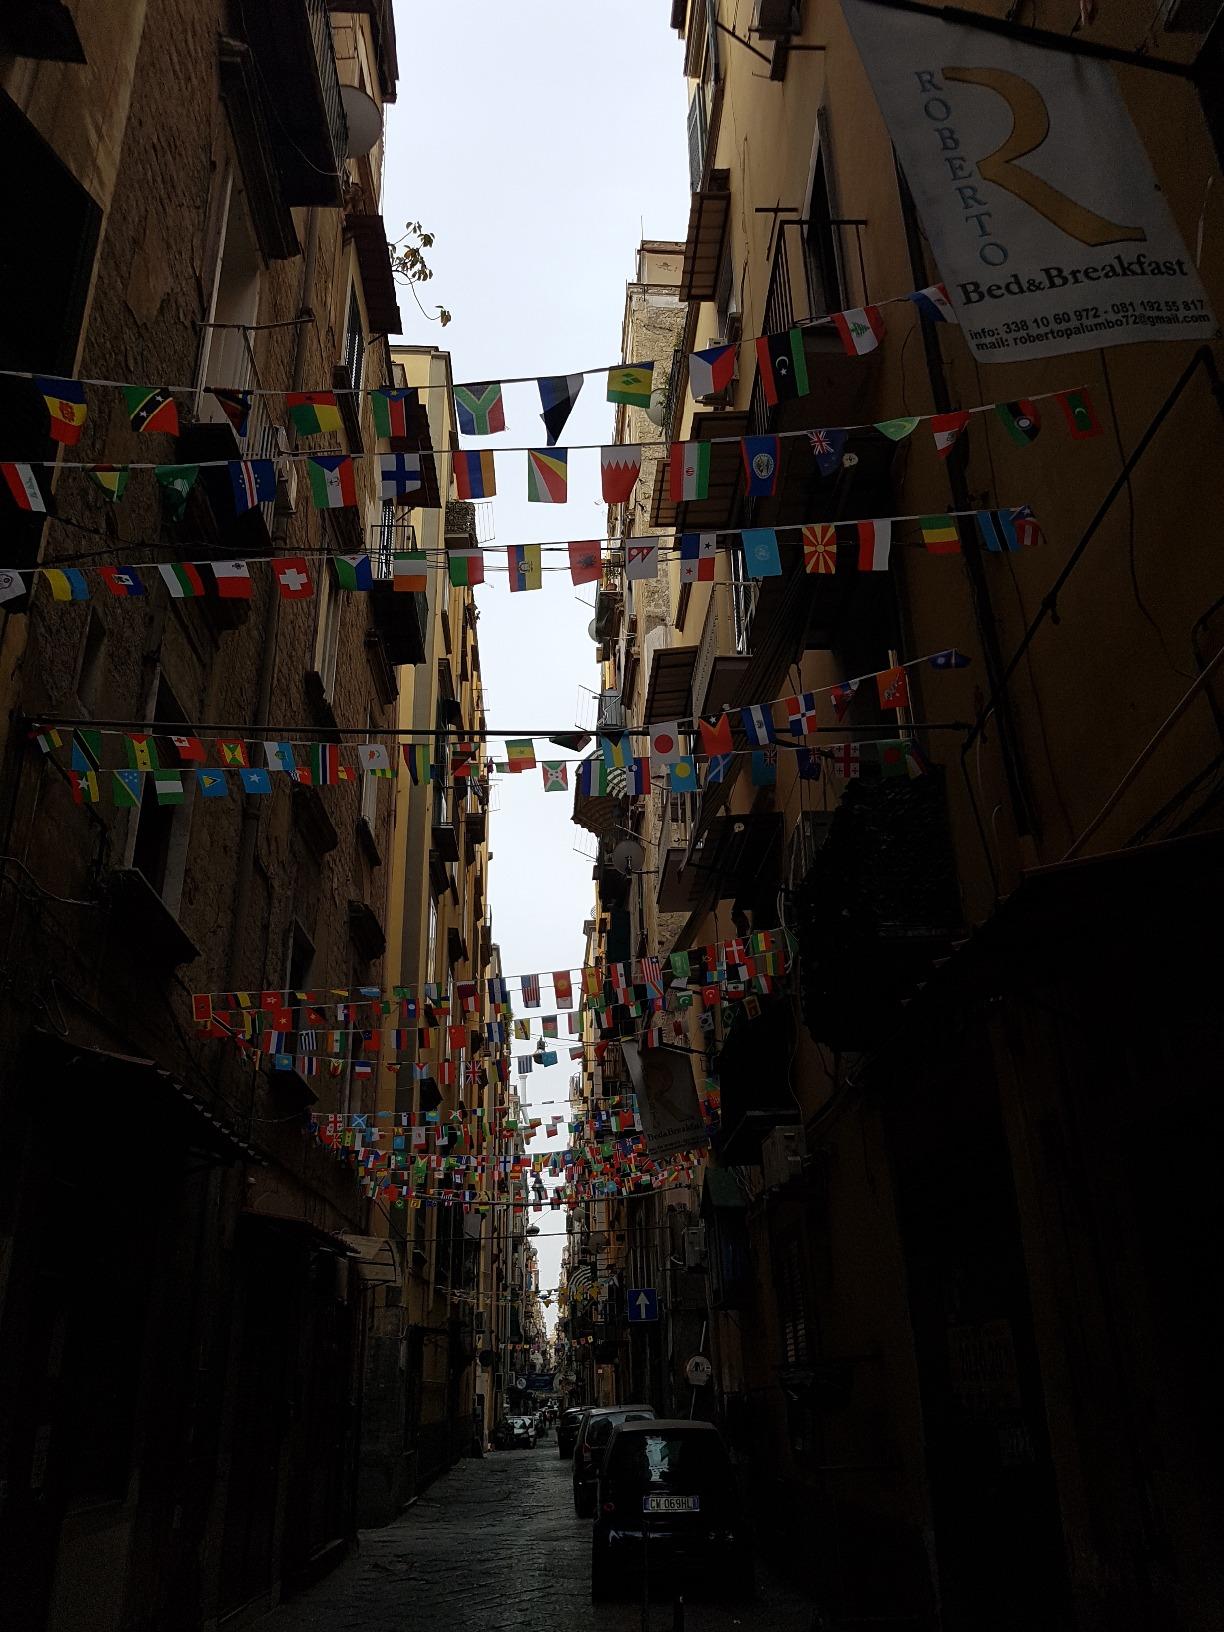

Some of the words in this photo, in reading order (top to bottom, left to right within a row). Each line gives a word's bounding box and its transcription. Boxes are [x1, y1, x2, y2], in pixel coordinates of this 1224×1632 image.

[915, 71, 1008, 266] ROBERTO
[957, 253, 1188, 305] Bed&Breakfast
[970, 327, 999, 340] info:
[1002, 321, 1029, 335] 338
[1032, 316, 1050, 330] 10
[1054, 312, 1071, 326] 60
[1074, 307, 1100, 323] 972
[1111, 301, 1136, 315] 081
[1165, 300, 1181, 312] 55
[1183, 299, 1205, 311] 817
[975, 336, 1010, 352] mail:
[1013, 313, 1210, 346] robertopalumbo72@gmail.com
